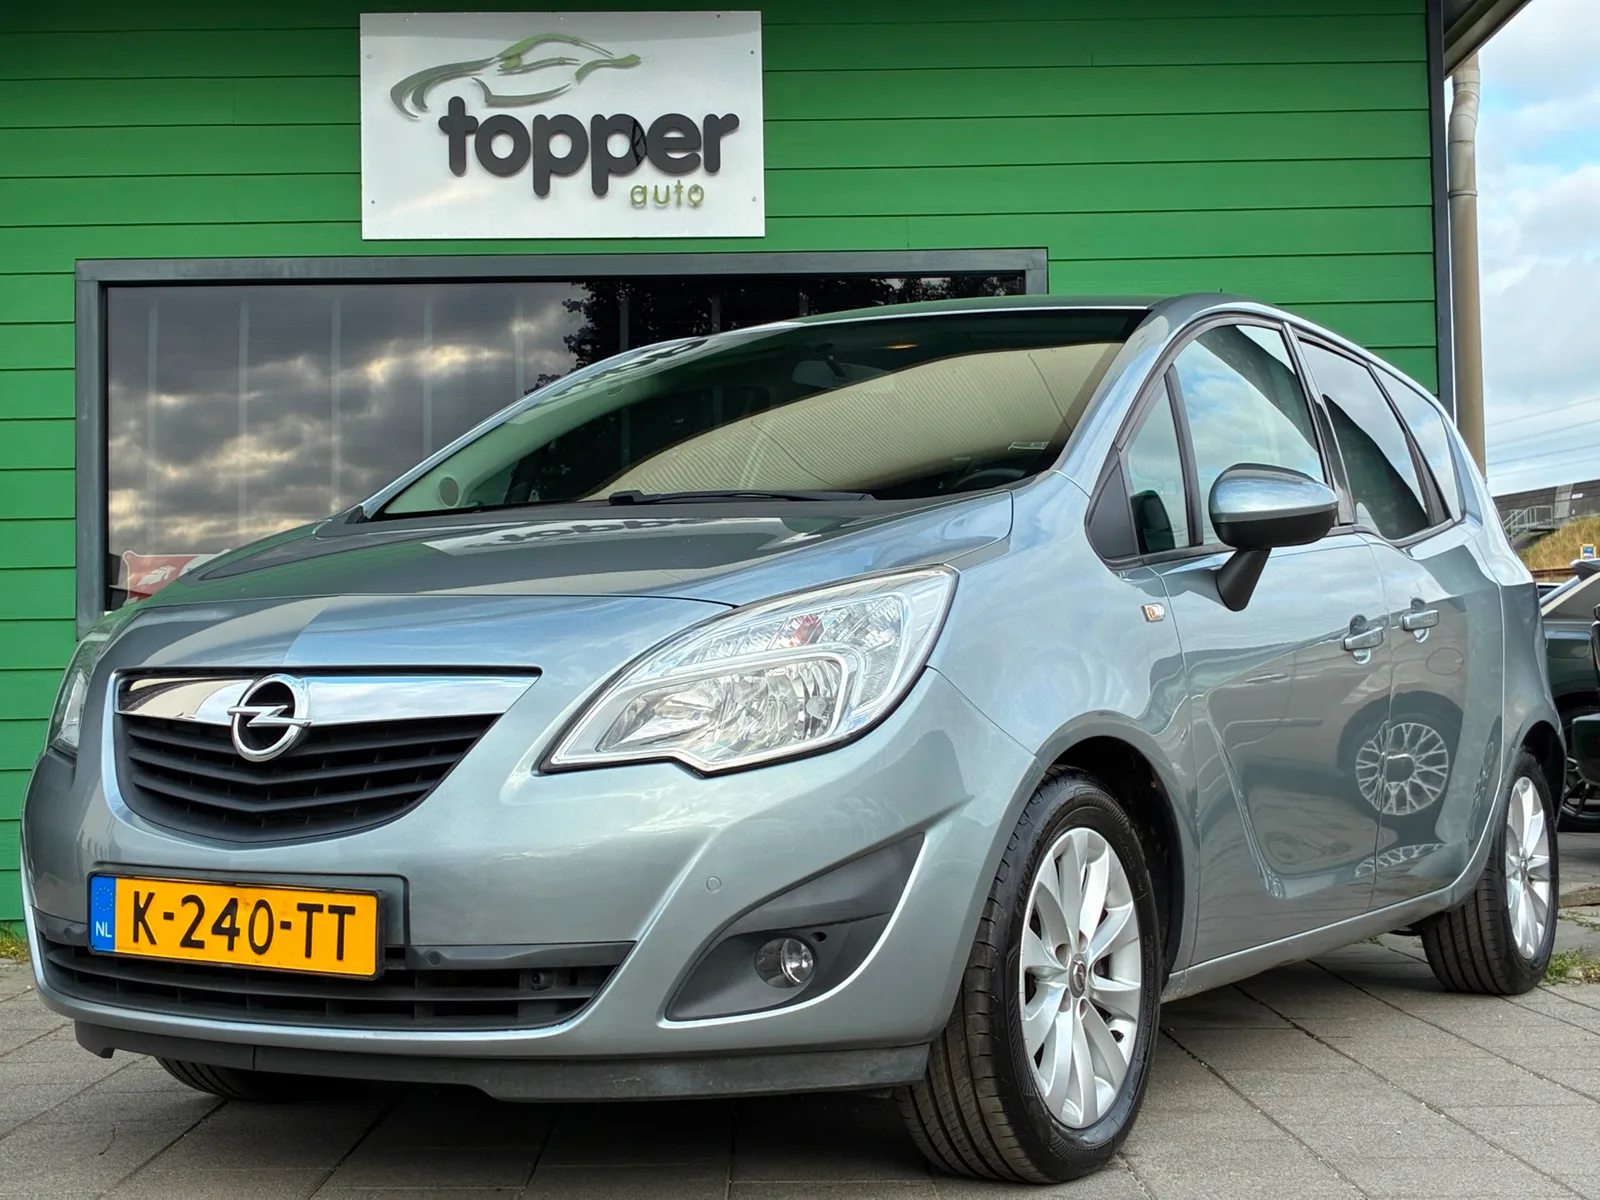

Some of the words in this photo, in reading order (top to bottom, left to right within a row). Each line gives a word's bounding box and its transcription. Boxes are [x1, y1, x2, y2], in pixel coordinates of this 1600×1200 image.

[438, 96, 740, 197] topper
[630, 179, 705, 207] auto
[95, 921, 113, 938] NL
[132, 890, 356, 961] K-240-TT
